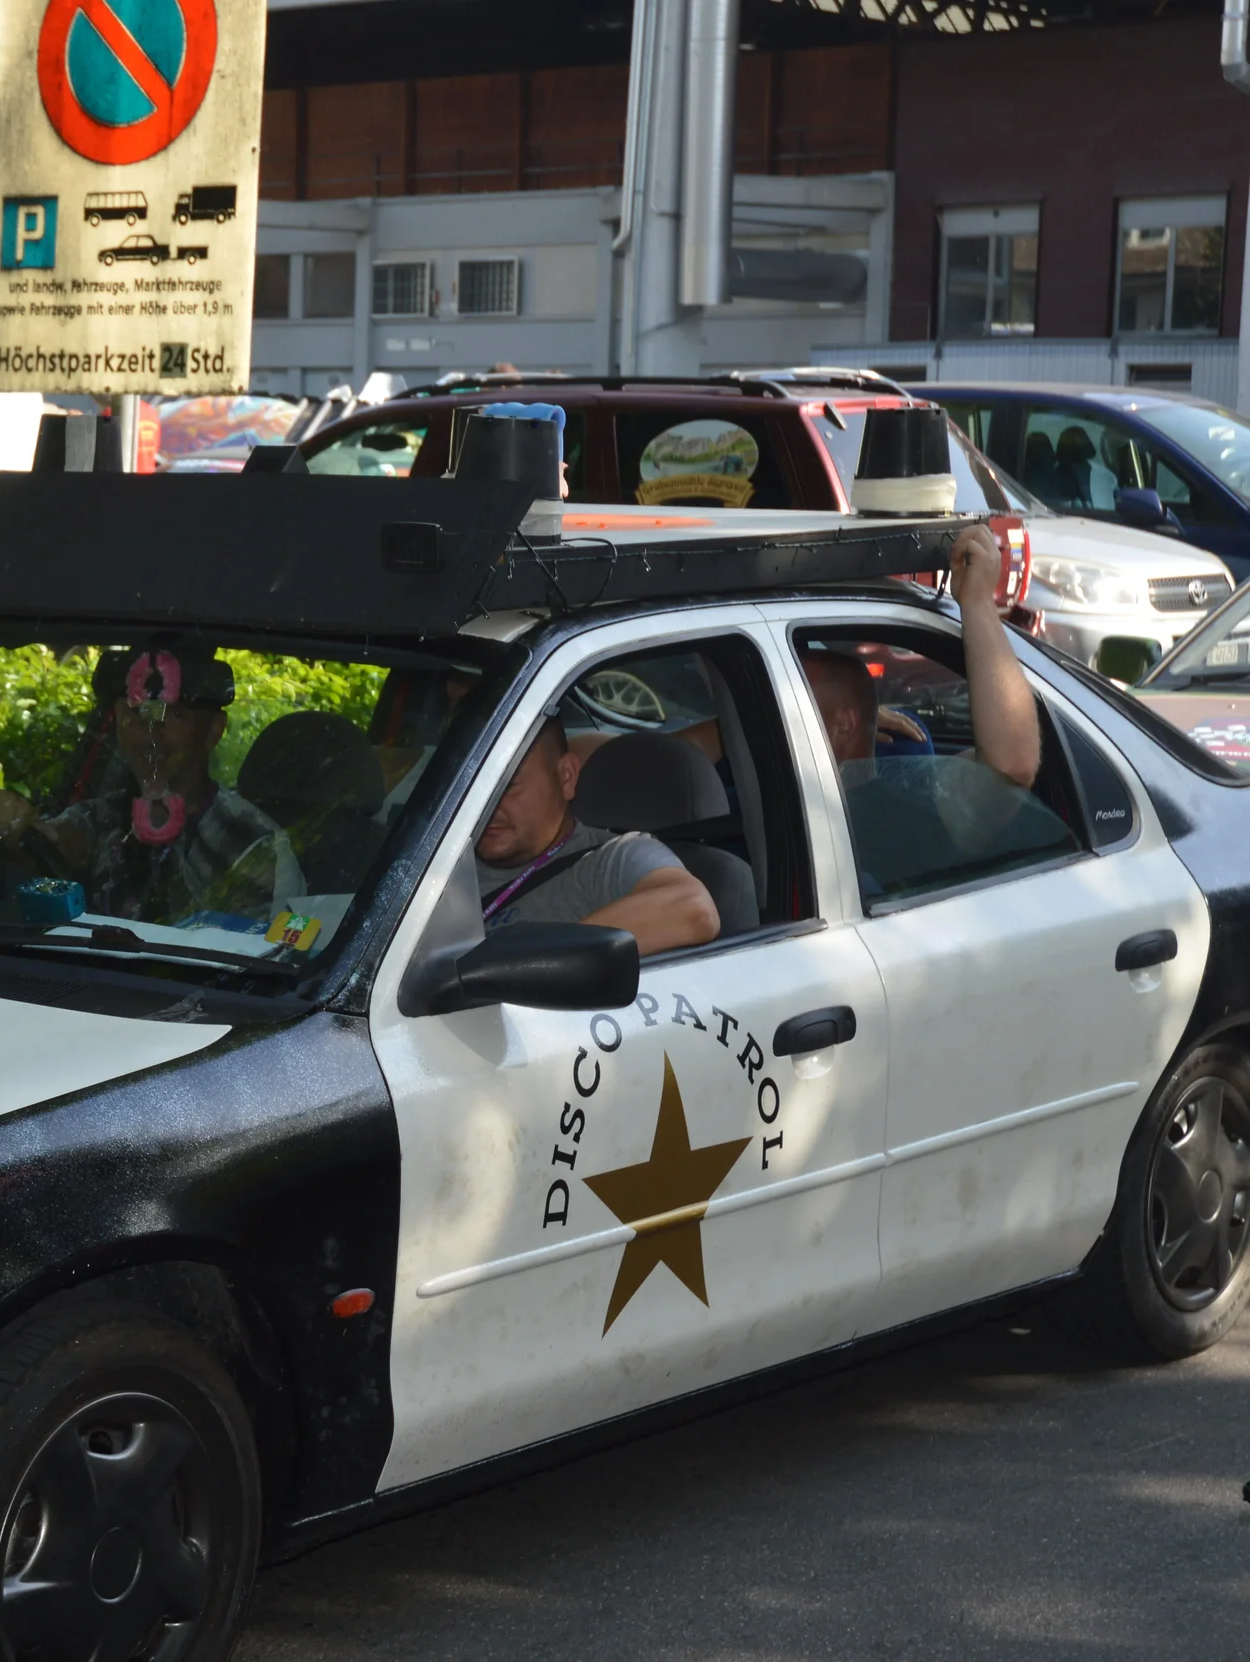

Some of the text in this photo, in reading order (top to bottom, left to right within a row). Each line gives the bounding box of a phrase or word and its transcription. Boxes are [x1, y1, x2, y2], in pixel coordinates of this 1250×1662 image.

[14, 204, 45, 263] P
[9, 279, 28, 293] und
[134, 278, 223, 294] Marktfahrzeuge
[30, 303, 83, 318] Fahrzeuge
[86, 302, 103, 315] mit
[108, 303, 135, 315] einer
[140, 301, 167, 316] Höhe
[172, 301, 198, 314] über
[203, 302, 219, 316] 1,9
[223, 306, 233, 315] m
[161, 346, 186, 373] 24
[190, 346, 231, 374] Std.
[282, 928, 302, 944] 15
[542, 992, 783, 1229] DISCO PATROL
